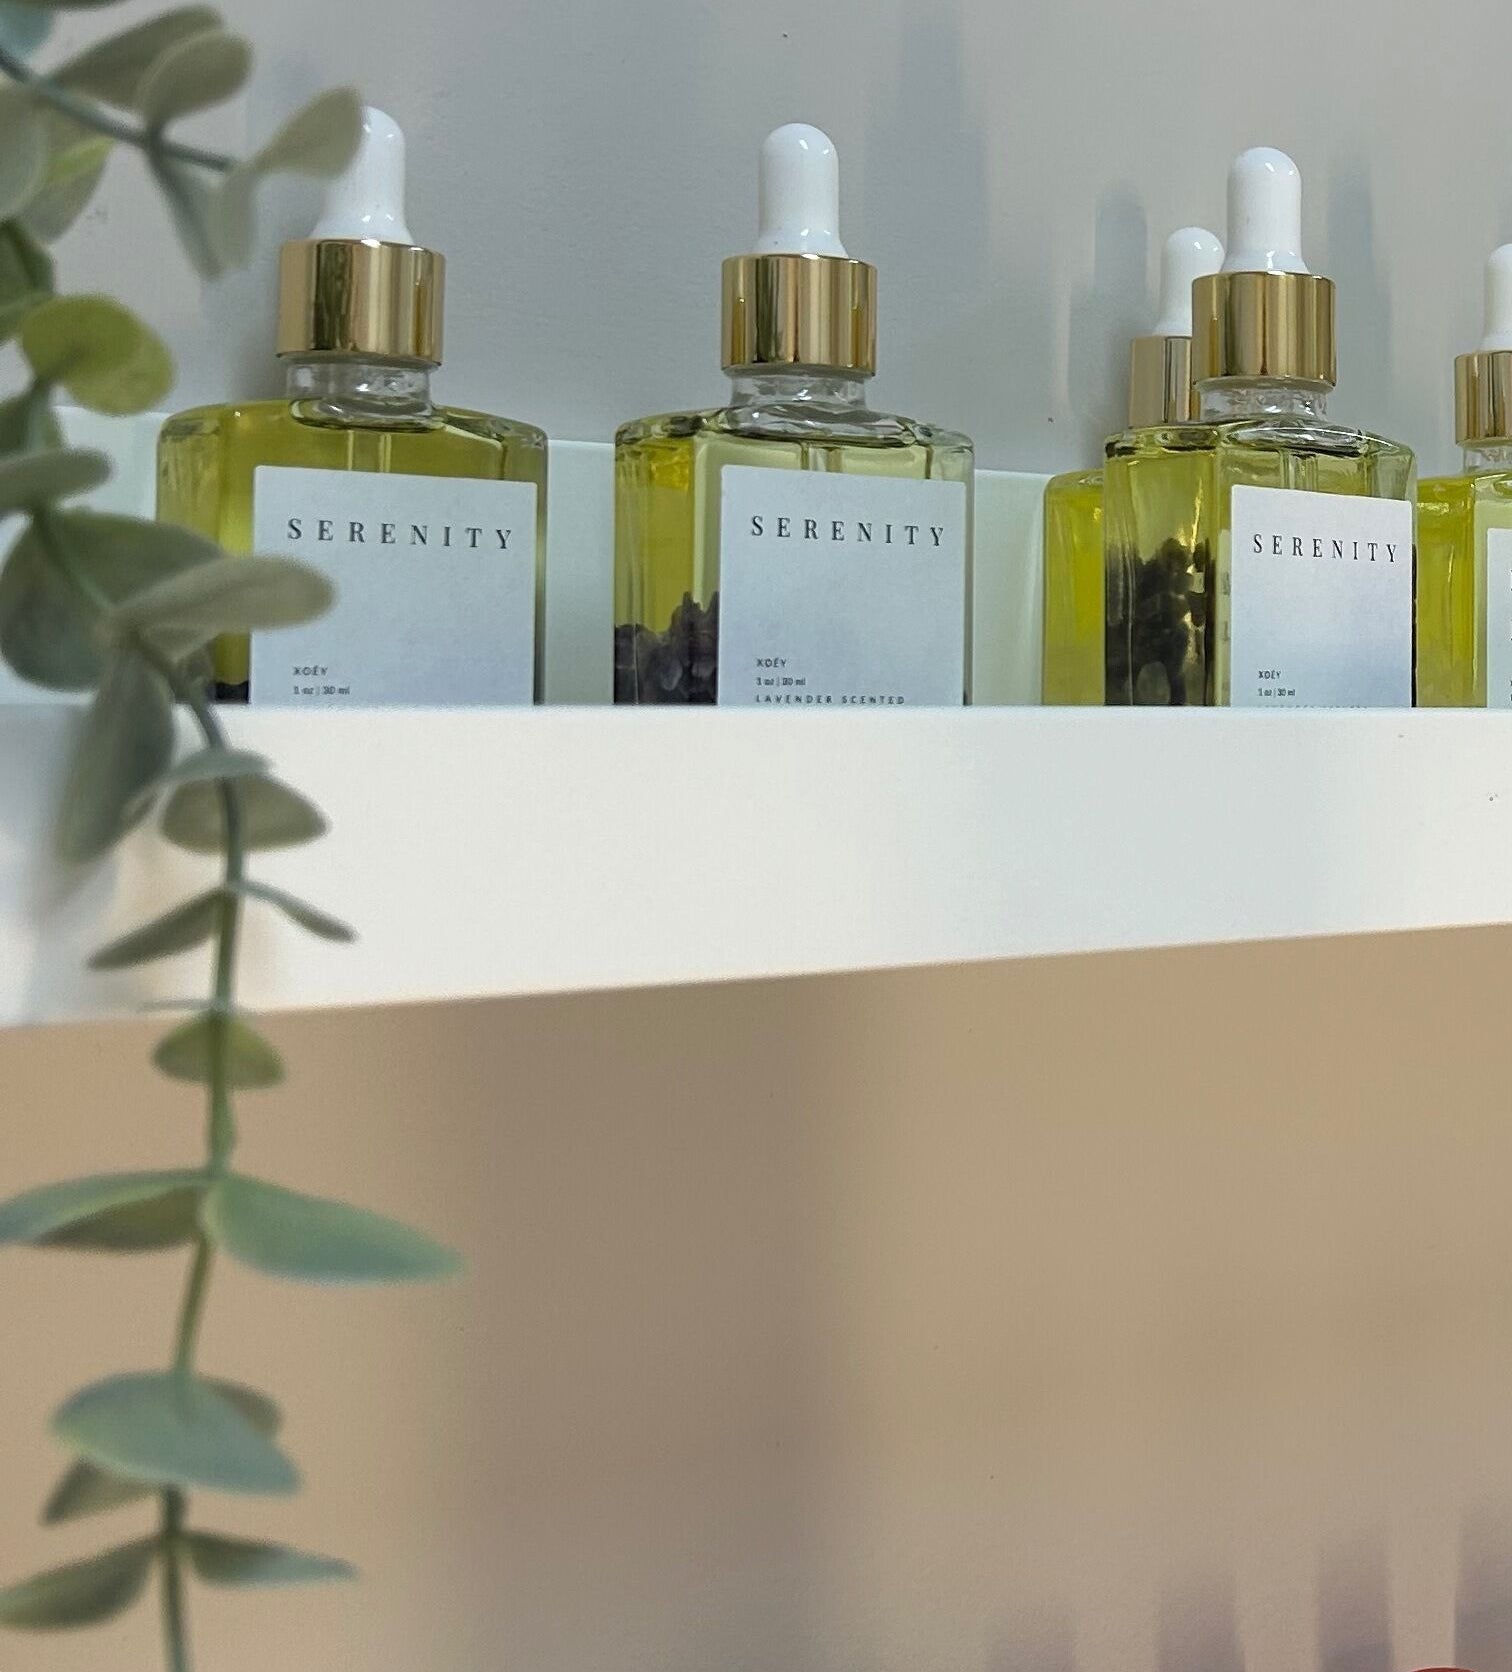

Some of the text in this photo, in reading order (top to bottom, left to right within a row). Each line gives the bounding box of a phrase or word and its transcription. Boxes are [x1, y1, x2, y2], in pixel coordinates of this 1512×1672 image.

[287, 518, 513, 550] SERENITY
[751, 515, 944, 547] SERENITY
[1253, 533, 1398, 563] SERENITY
[756, 694, 905, 705] LAVENDER SCENTED
